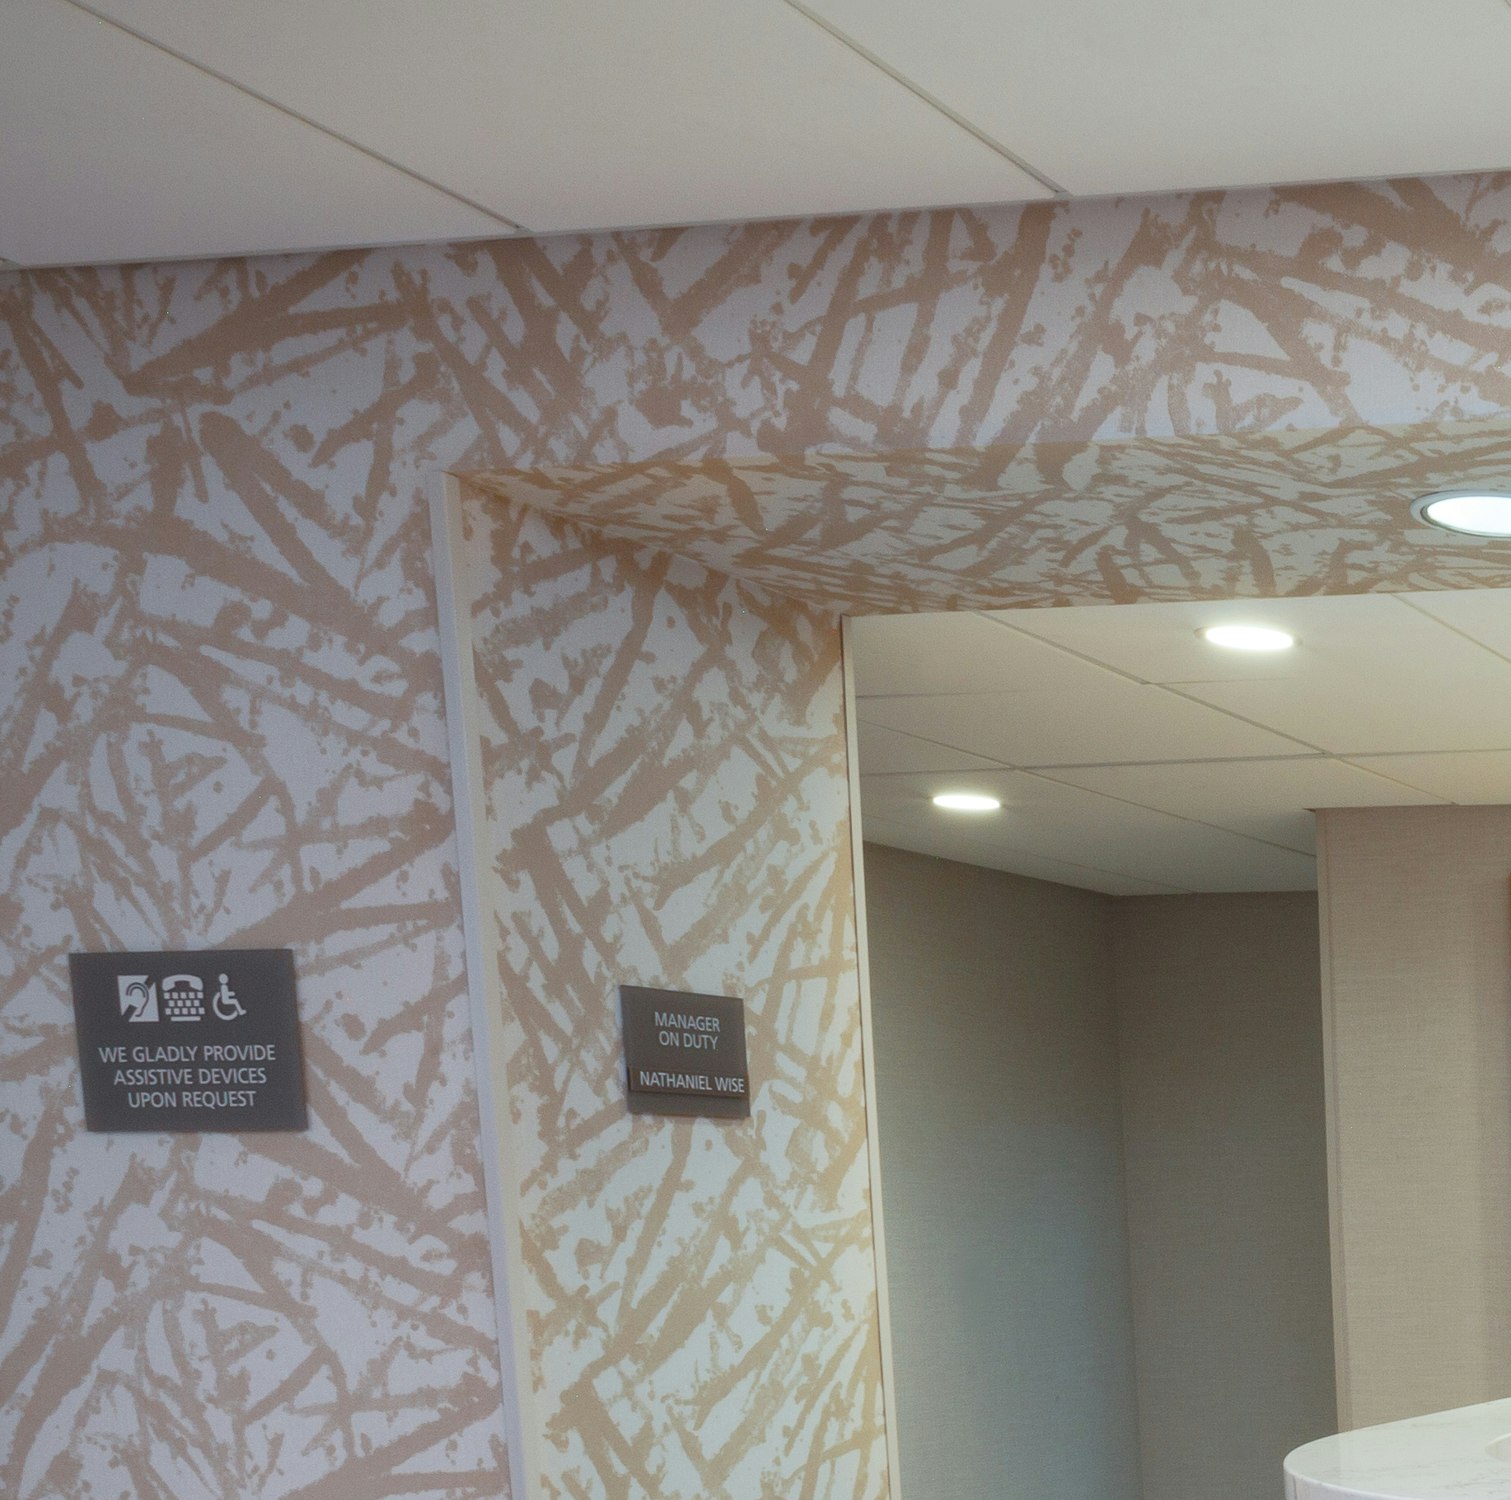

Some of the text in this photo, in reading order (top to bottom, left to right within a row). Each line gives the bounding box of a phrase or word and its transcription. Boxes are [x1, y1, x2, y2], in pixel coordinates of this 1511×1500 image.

[655, 1011, 720, 1032] MANAGER
[659, 1031, 719, 1050] ON DUTY
[98, 1044, 276, 1063] WE GLADLY PROVIDE
[113, 1067, 267, 1086] ASSISTIVE DEVICES
[639, 1070, 745, 1093] NATHANIEL WISE
[128, 1090, 257, 1109] UPON REQUEST
